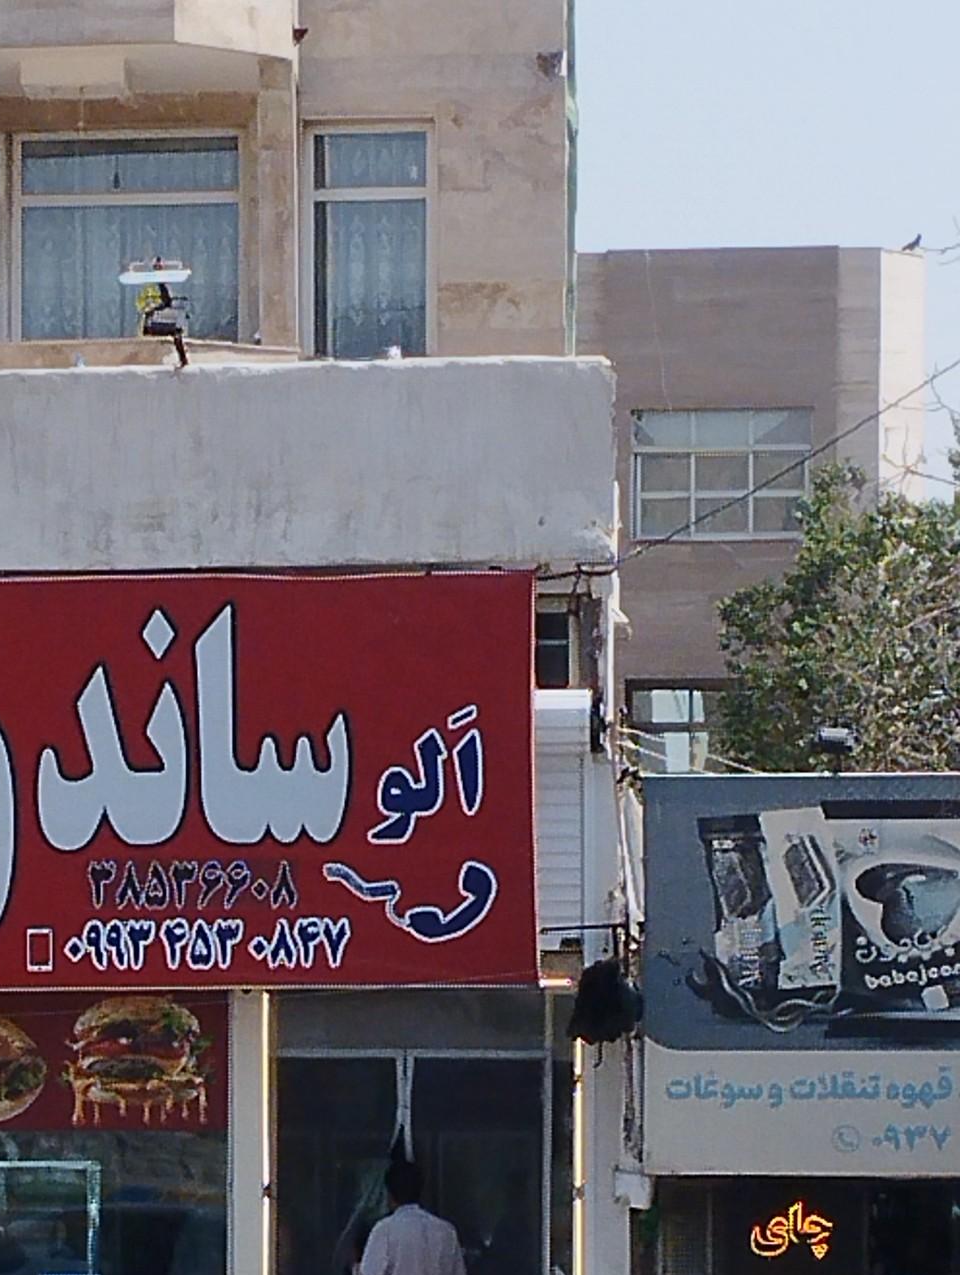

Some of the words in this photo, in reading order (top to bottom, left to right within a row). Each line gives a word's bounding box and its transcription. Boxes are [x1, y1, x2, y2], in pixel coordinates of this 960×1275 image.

[64, 918, 155, 970] ۰۹۹۳
[159, 917, 244, 970] ۴۵۳
[248, 917, 351, 970] ۰۸۴۷
[665, 1071, 764, 1109] سوغات
[768, 1081, 783, 1108] و
[790, 1071, 881, 1100] تنقلات
[886, 1065, 953, 1108] قهوه
[872, 1124, 951, 1151] ۰۹۳۷
[750, 1201, 833, 1259] چای
